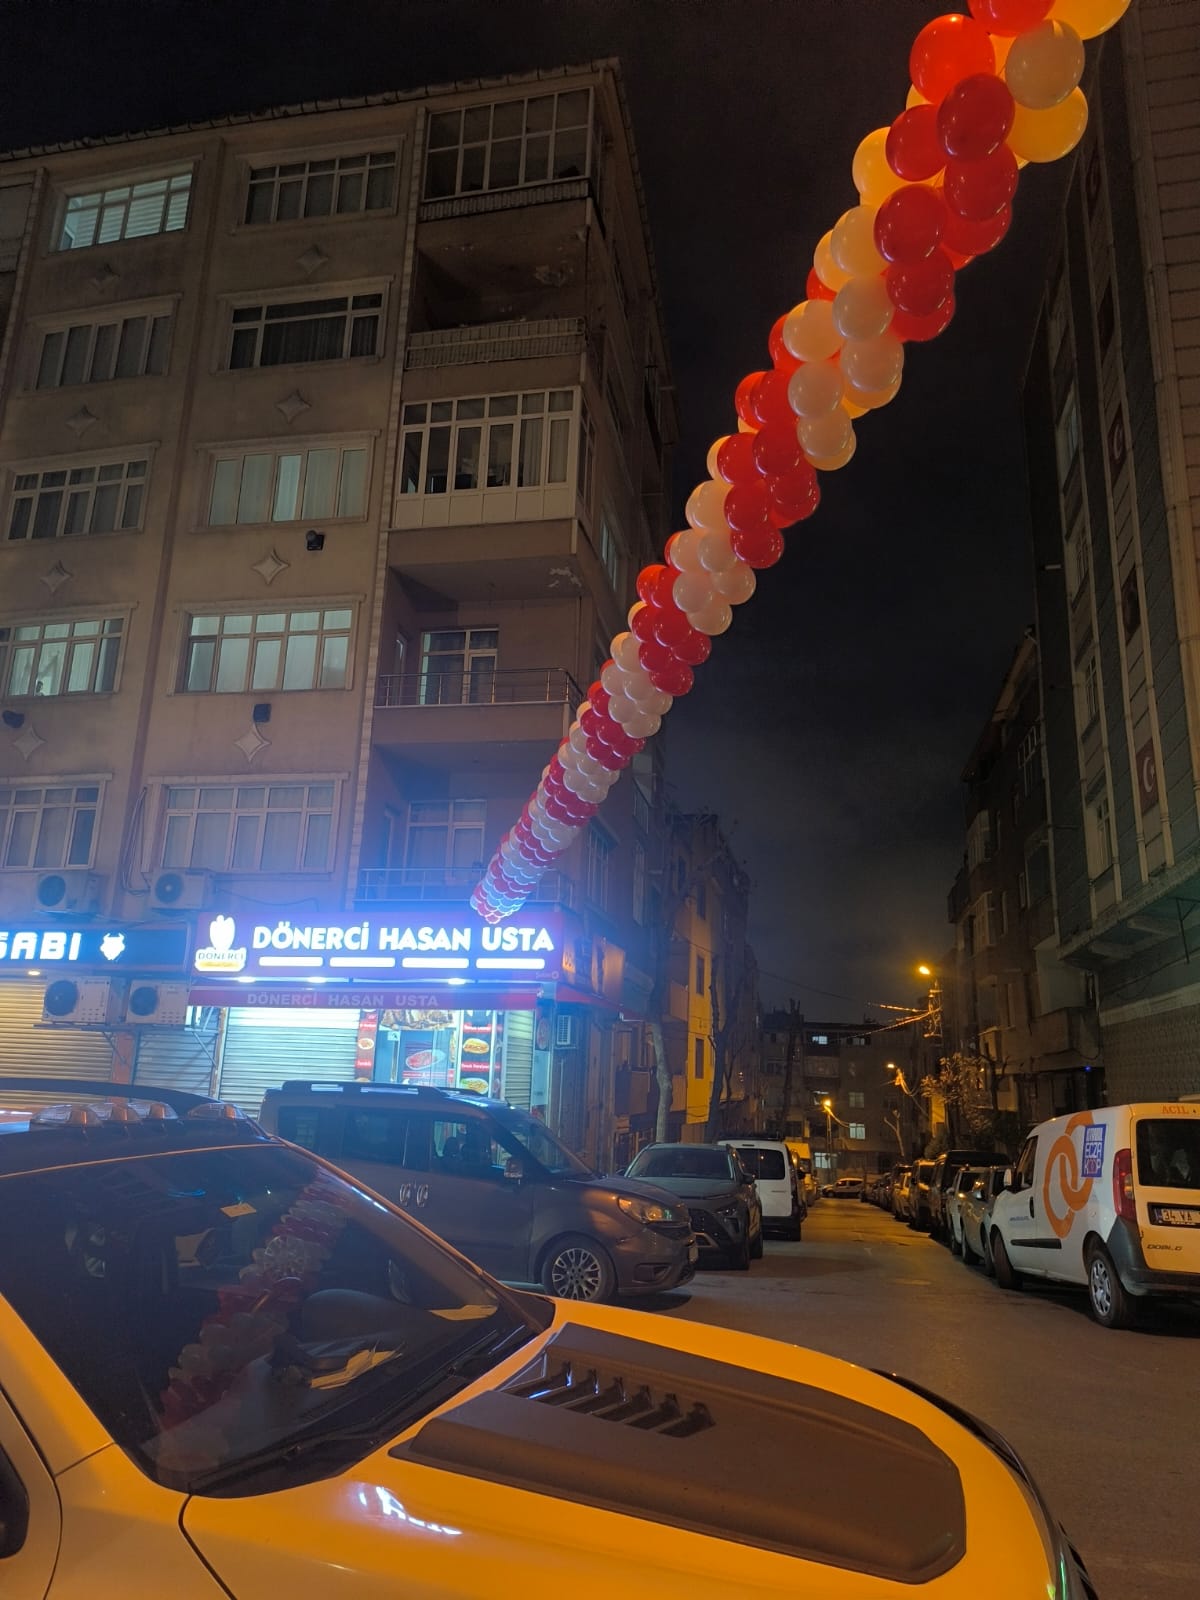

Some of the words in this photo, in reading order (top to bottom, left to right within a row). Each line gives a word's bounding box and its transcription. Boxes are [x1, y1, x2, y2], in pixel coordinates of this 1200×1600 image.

[252, 921, 370, 950] DÖNERCİ
[379, 927, 471, 951] HASAN
[481, 927, 554, 951] USTA
[247, 990, 317, 1006] DÖNERCİ
[328, 994, 384, 1007] HASAN
[395, 995, 439, 1007] USTA
